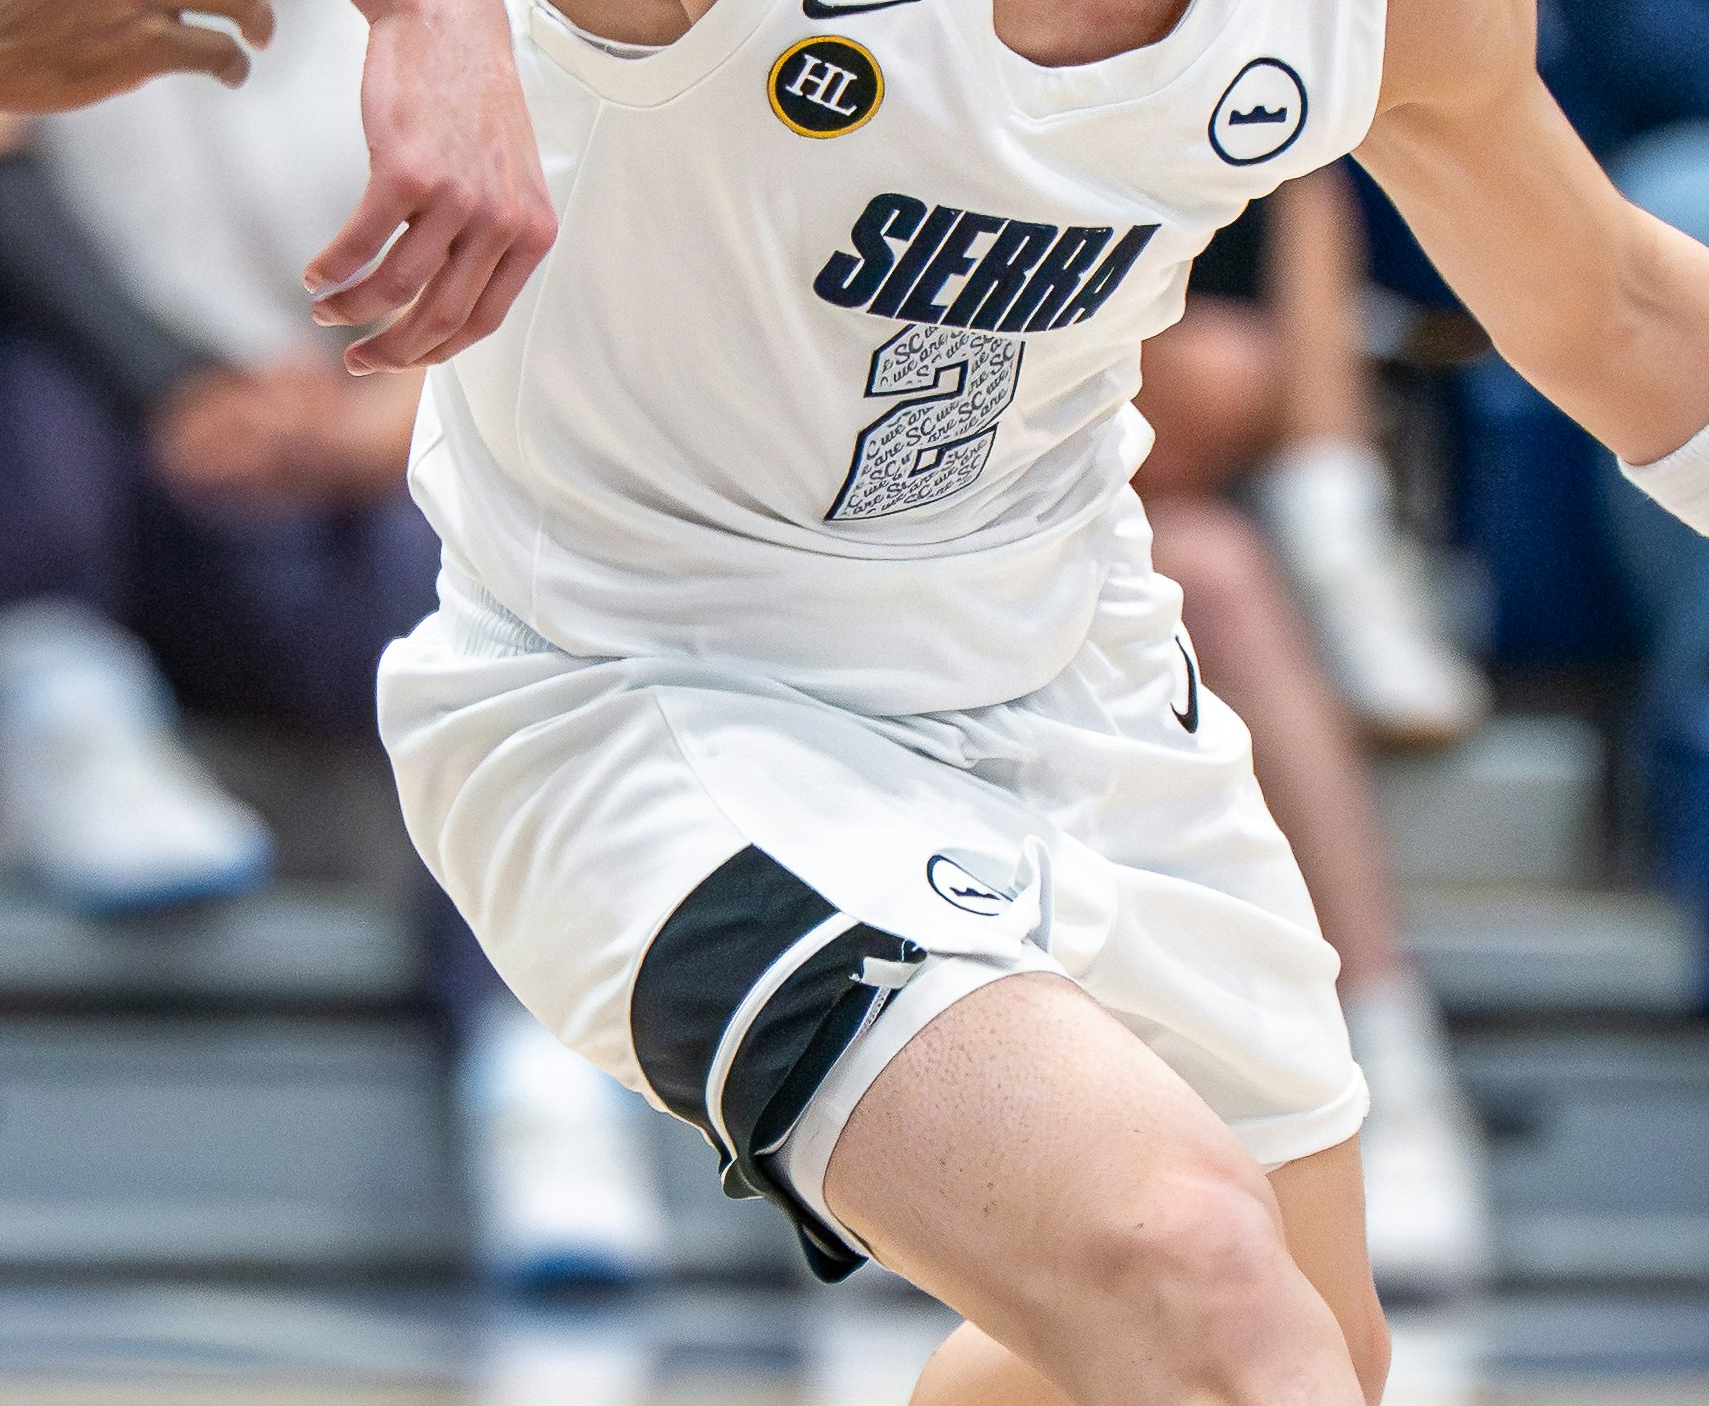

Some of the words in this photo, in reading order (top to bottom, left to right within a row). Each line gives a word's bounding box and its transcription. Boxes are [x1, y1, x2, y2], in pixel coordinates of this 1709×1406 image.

[784, 53, 858, 116] HL
[812, 192, 1162, 333] SIERRA
[823, 323, 1026, 521] 2
[905, 417, 936, 447] SC
